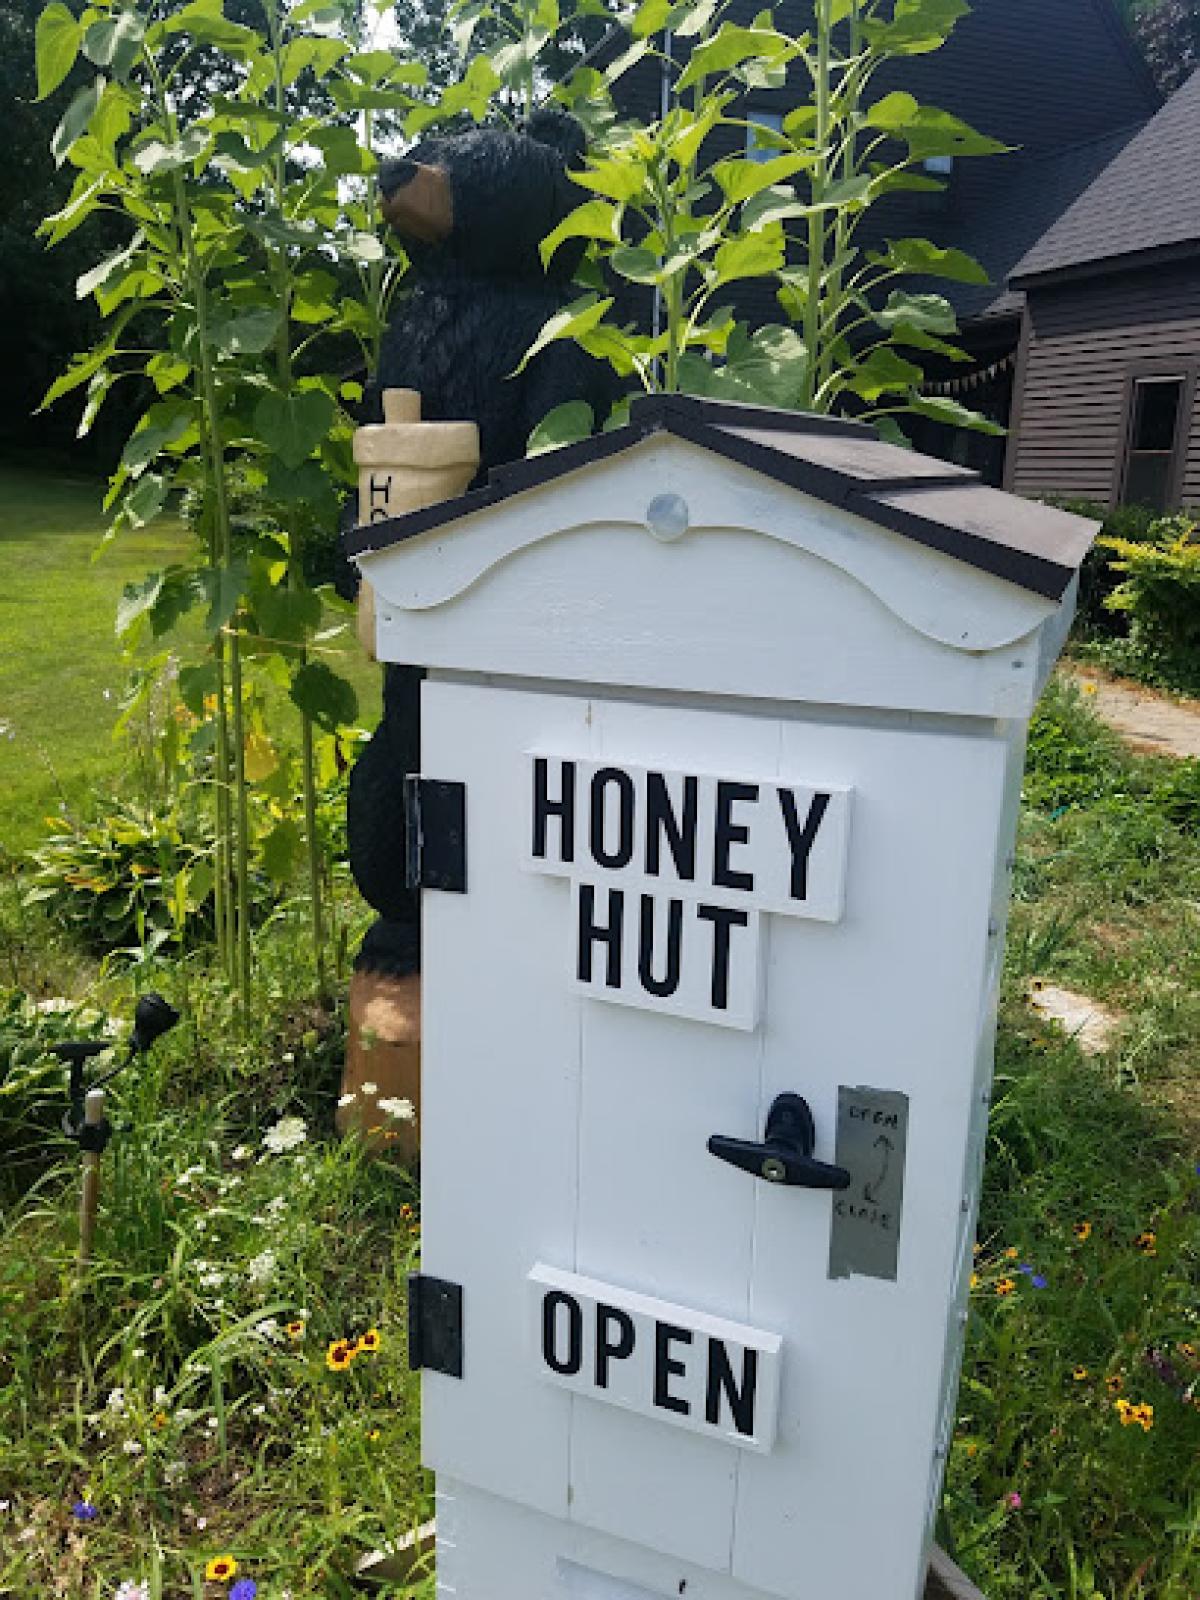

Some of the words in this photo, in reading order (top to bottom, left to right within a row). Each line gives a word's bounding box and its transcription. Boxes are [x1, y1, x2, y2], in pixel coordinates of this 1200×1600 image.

[532, 758, 831, 901] HONEY
[577, 884, 748, 1010] HUT
[849, 1105, 898, 1130] OPEN
[542, 1290, 757, 1436] OPEN
